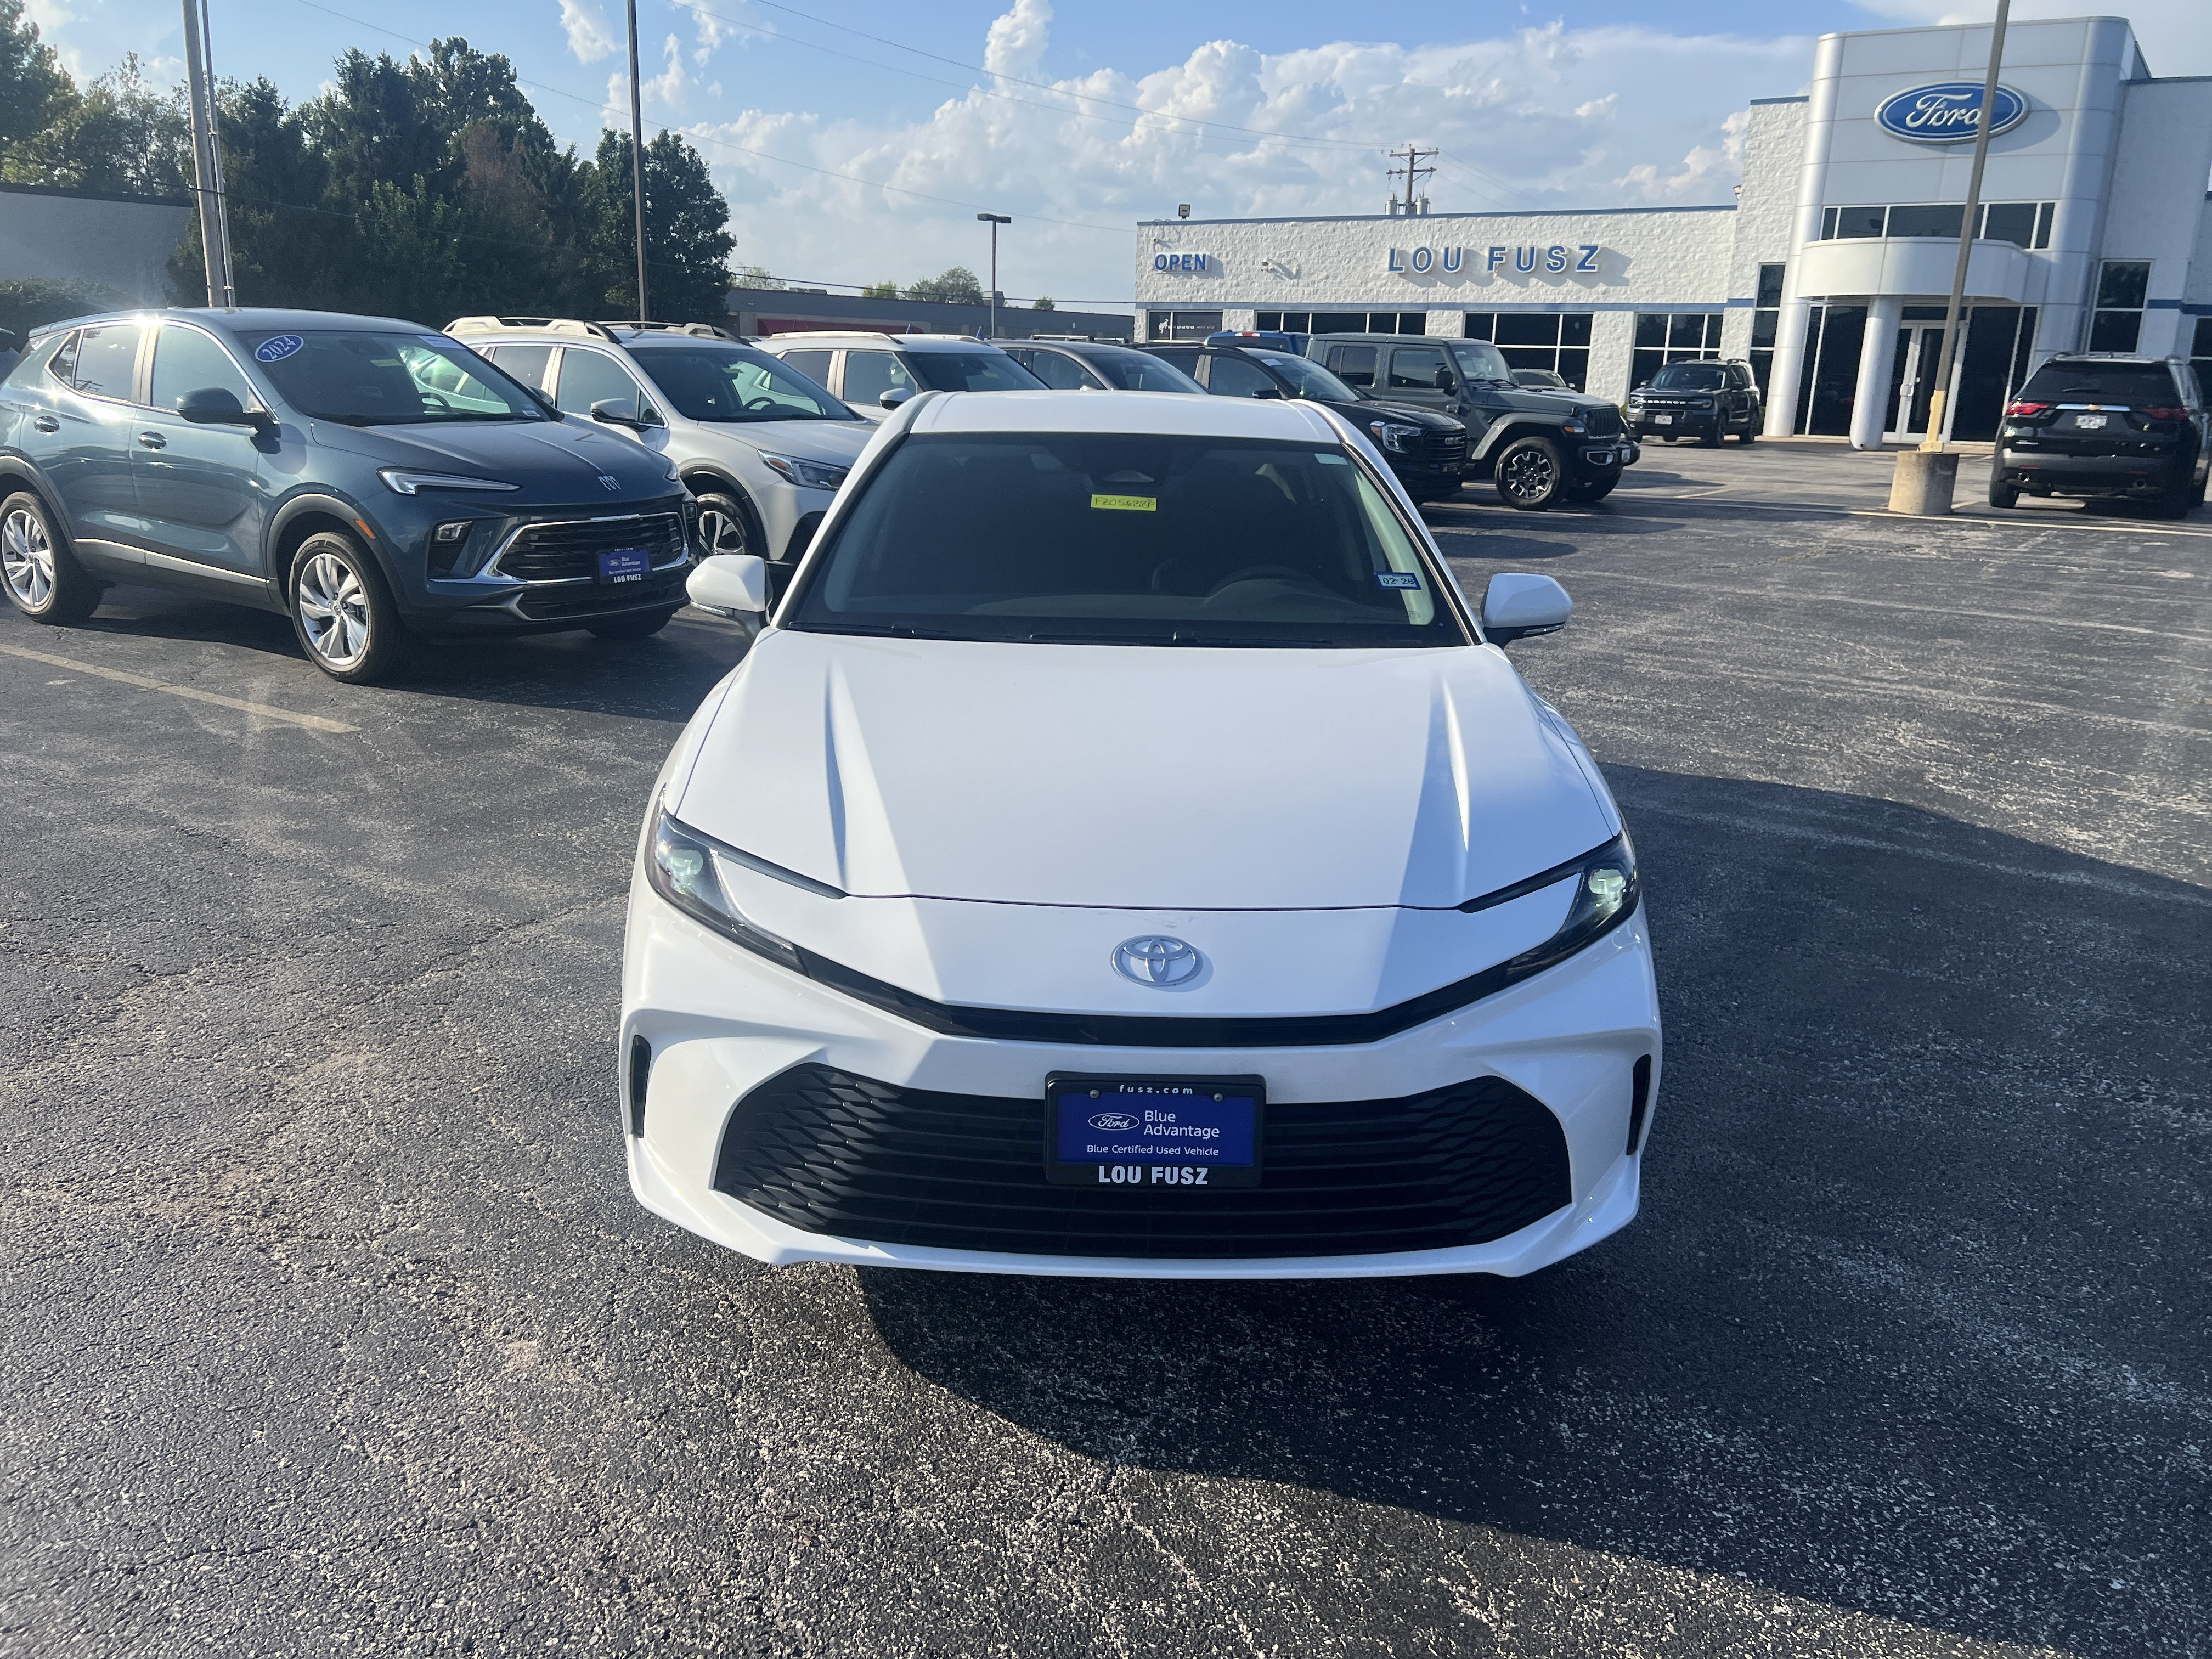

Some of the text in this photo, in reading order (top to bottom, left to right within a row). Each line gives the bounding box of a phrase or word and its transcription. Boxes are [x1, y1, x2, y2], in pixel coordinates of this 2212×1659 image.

[1155, 253, 1206, 270] OPEN
[1388, 245, 1600, 273] LOU FUSZ
[262, 336, 296, 359] 2024
[1119, 1085, 1193, 1094] fusz.com
[1098, 1115, 1130, 1128] Ford
[1144, 1110, 1176, 1122] Blue
[1143, 1124, 1220, 1139] Advantage
[1111, 1145, 1153, 1154] Certified
[1184, 1147, 1219, 1155] Vehicle
[1098, 1165, 1208, 1185] LOU FUSZ
